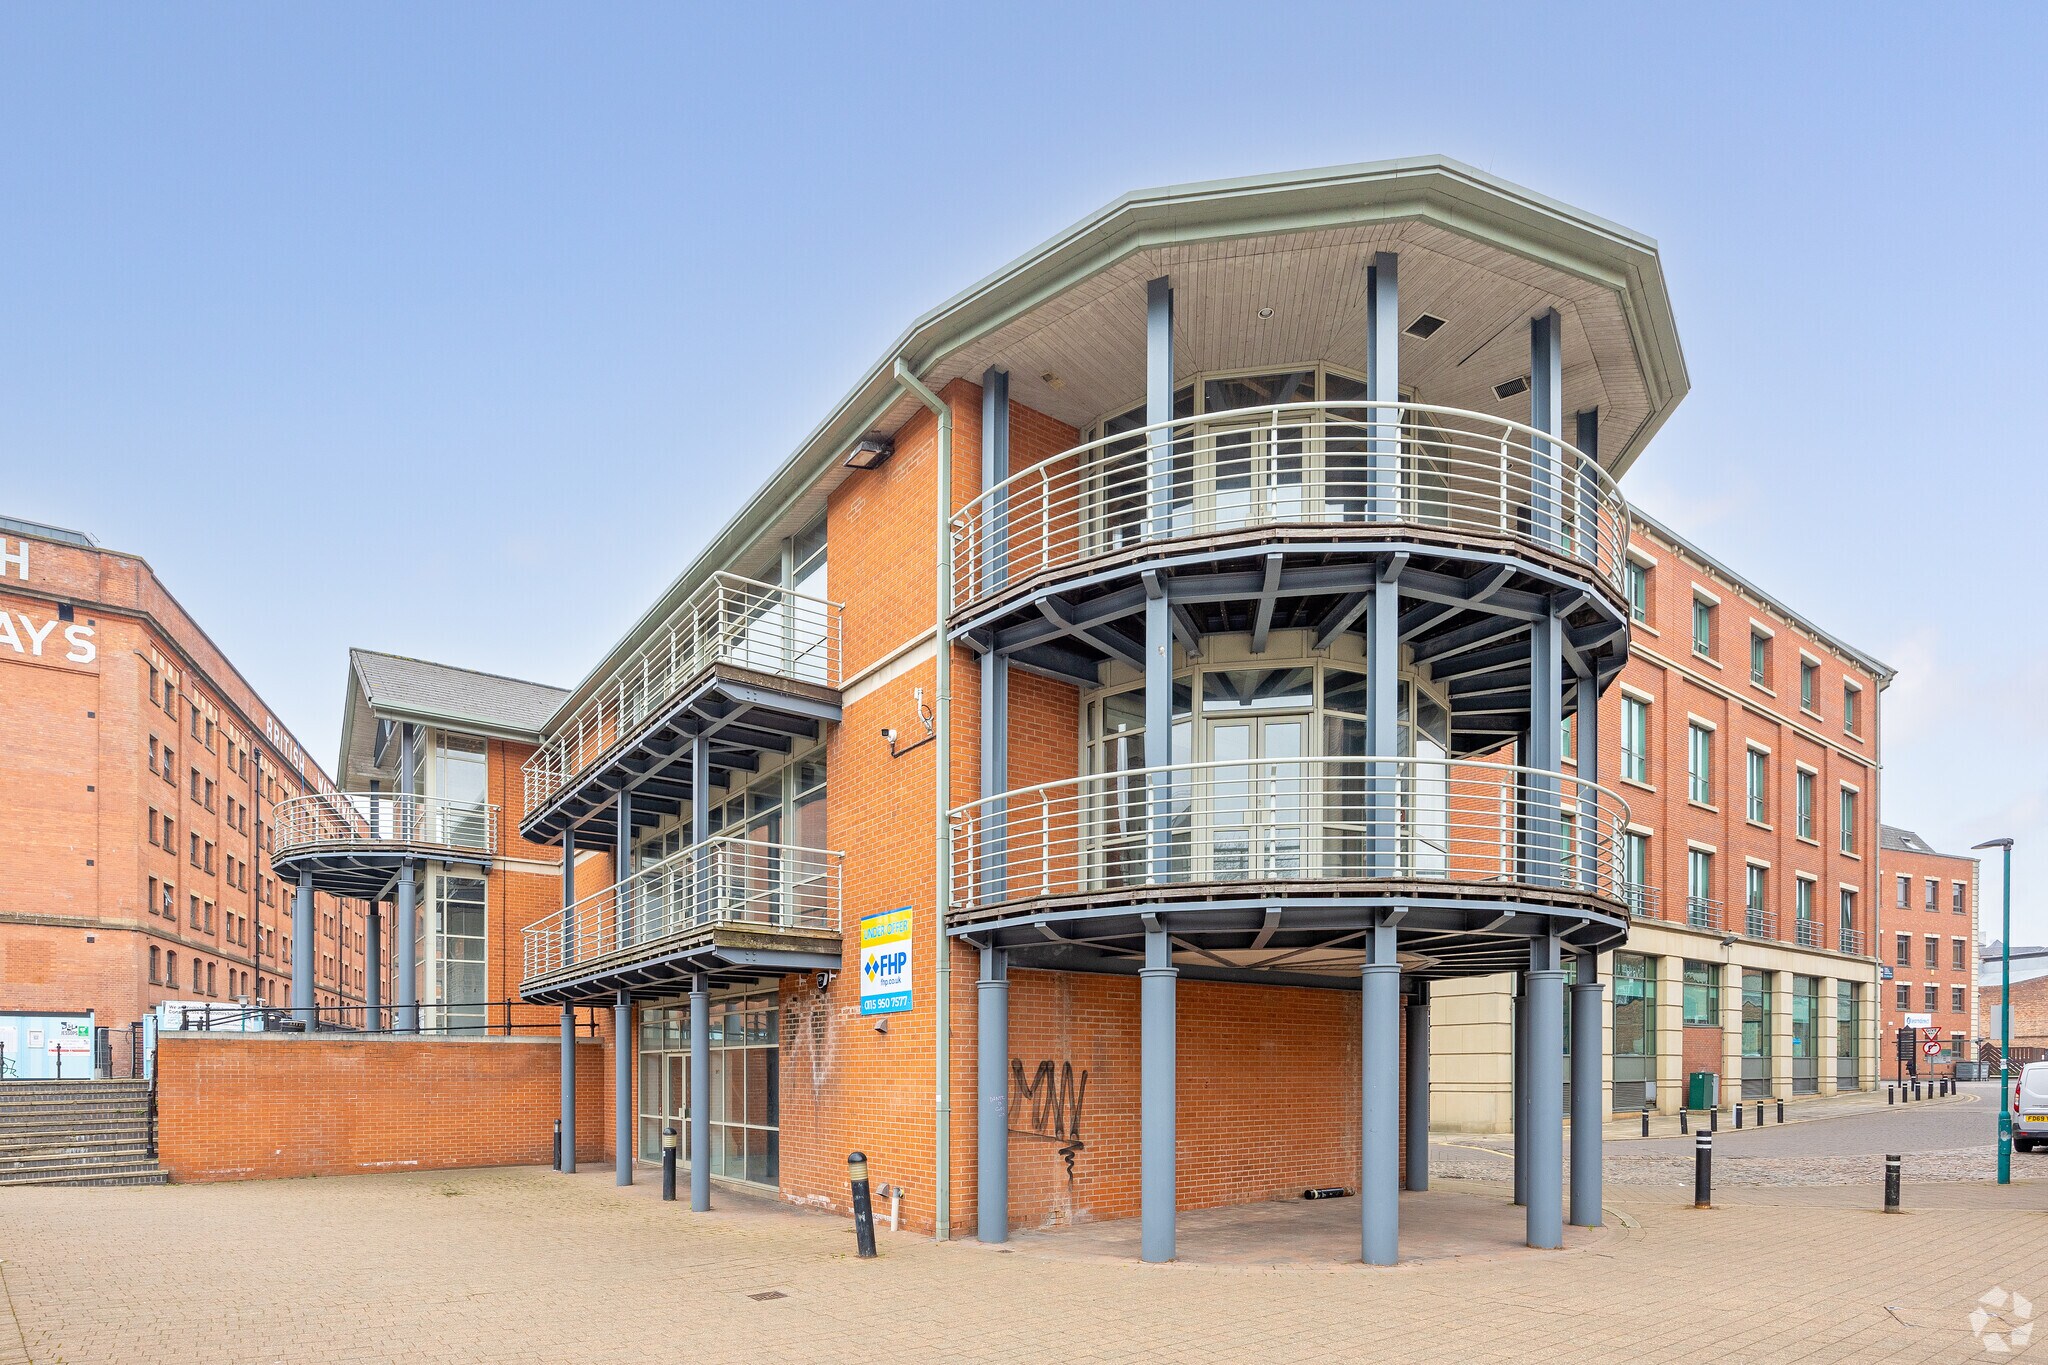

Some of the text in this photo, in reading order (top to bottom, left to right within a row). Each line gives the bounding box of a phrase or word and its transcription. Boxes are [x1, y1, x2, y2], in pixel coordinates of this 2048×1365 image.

[266, 715, 305, 776] BRITISH
[887, 920, 907, 934] OFFER
[880, 952, 907, 976] FHP
[880, 976, 902, 987] fhp.co.uk
[877, 998, 890, 1009] 950
[890, 996, 908, 1008] 7577
